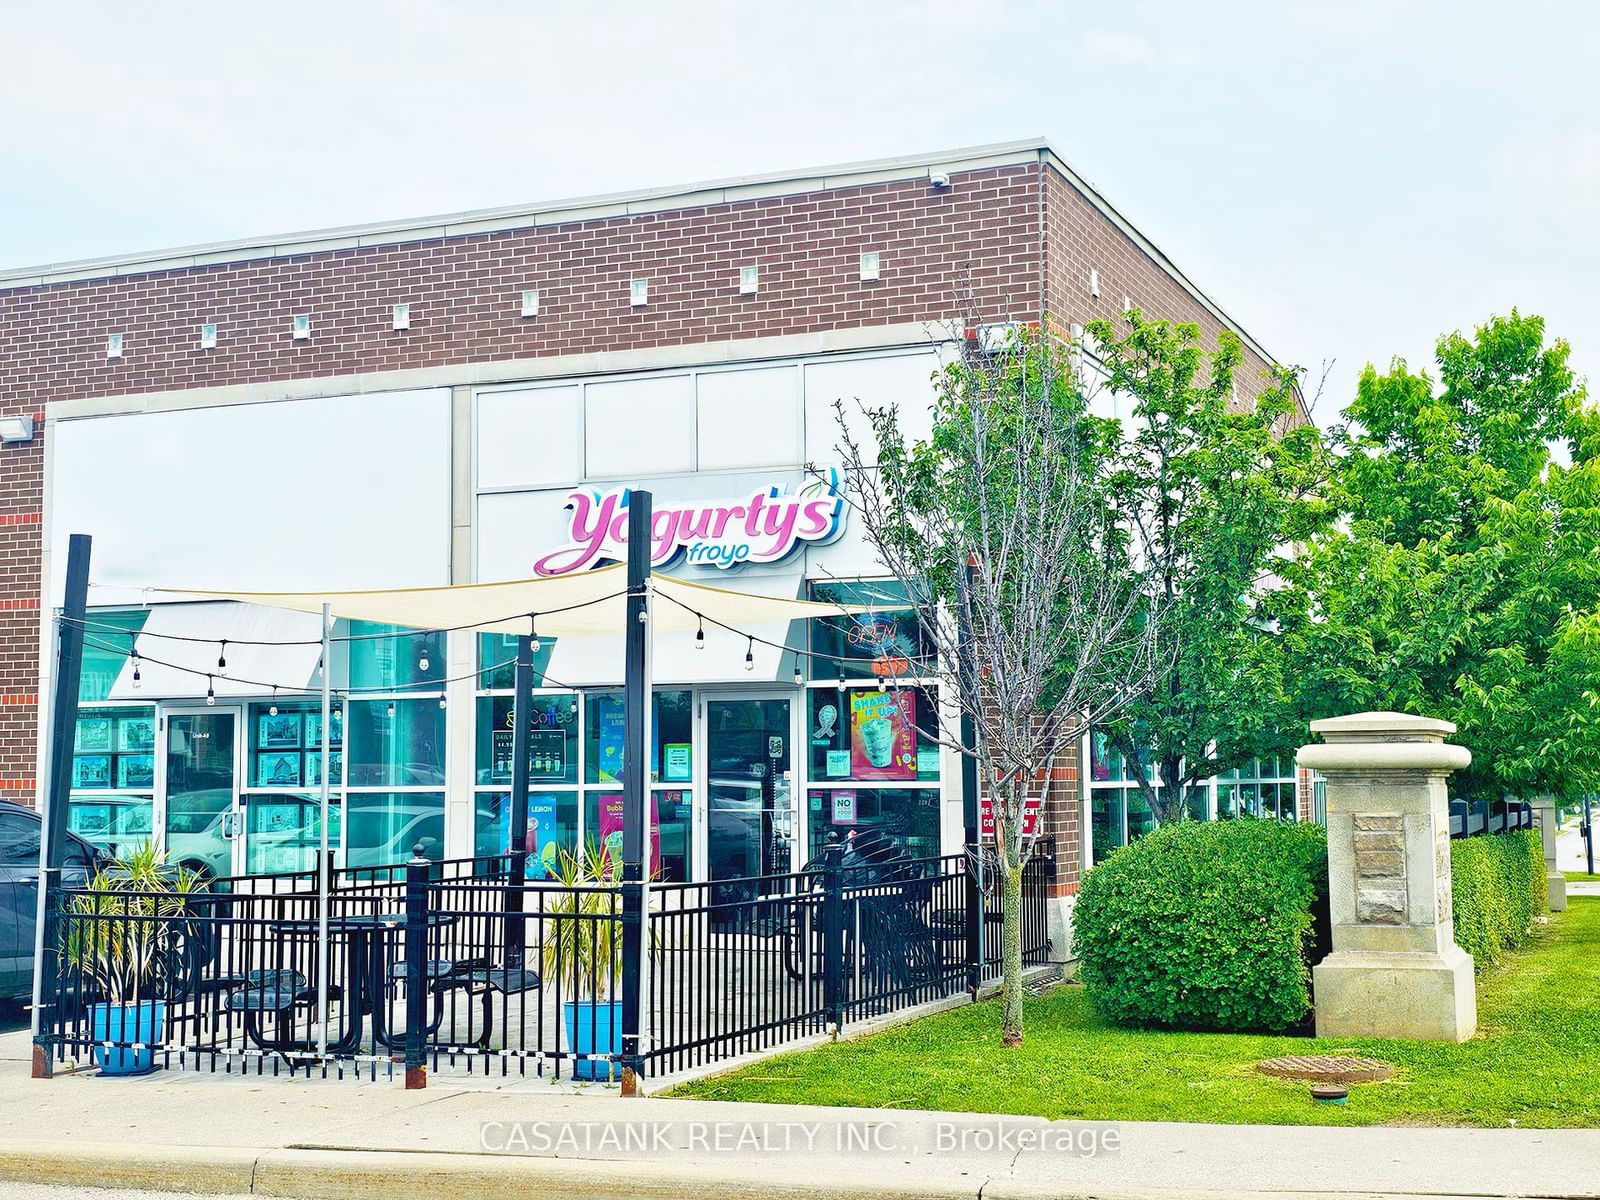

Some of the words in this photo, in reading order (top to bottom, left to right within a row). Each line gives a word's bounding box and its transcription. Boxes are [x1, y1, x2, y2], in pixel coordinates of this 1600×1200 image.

[689, 543, 749, 565] froyo
[848, 623, 897, 643] OPEN
[854, 694, 891, 710] SHAKE
[529, 706, 573, 727] Coffee
[864, 708, 874, 717] IT
[837, 799, 851, 807] NO
